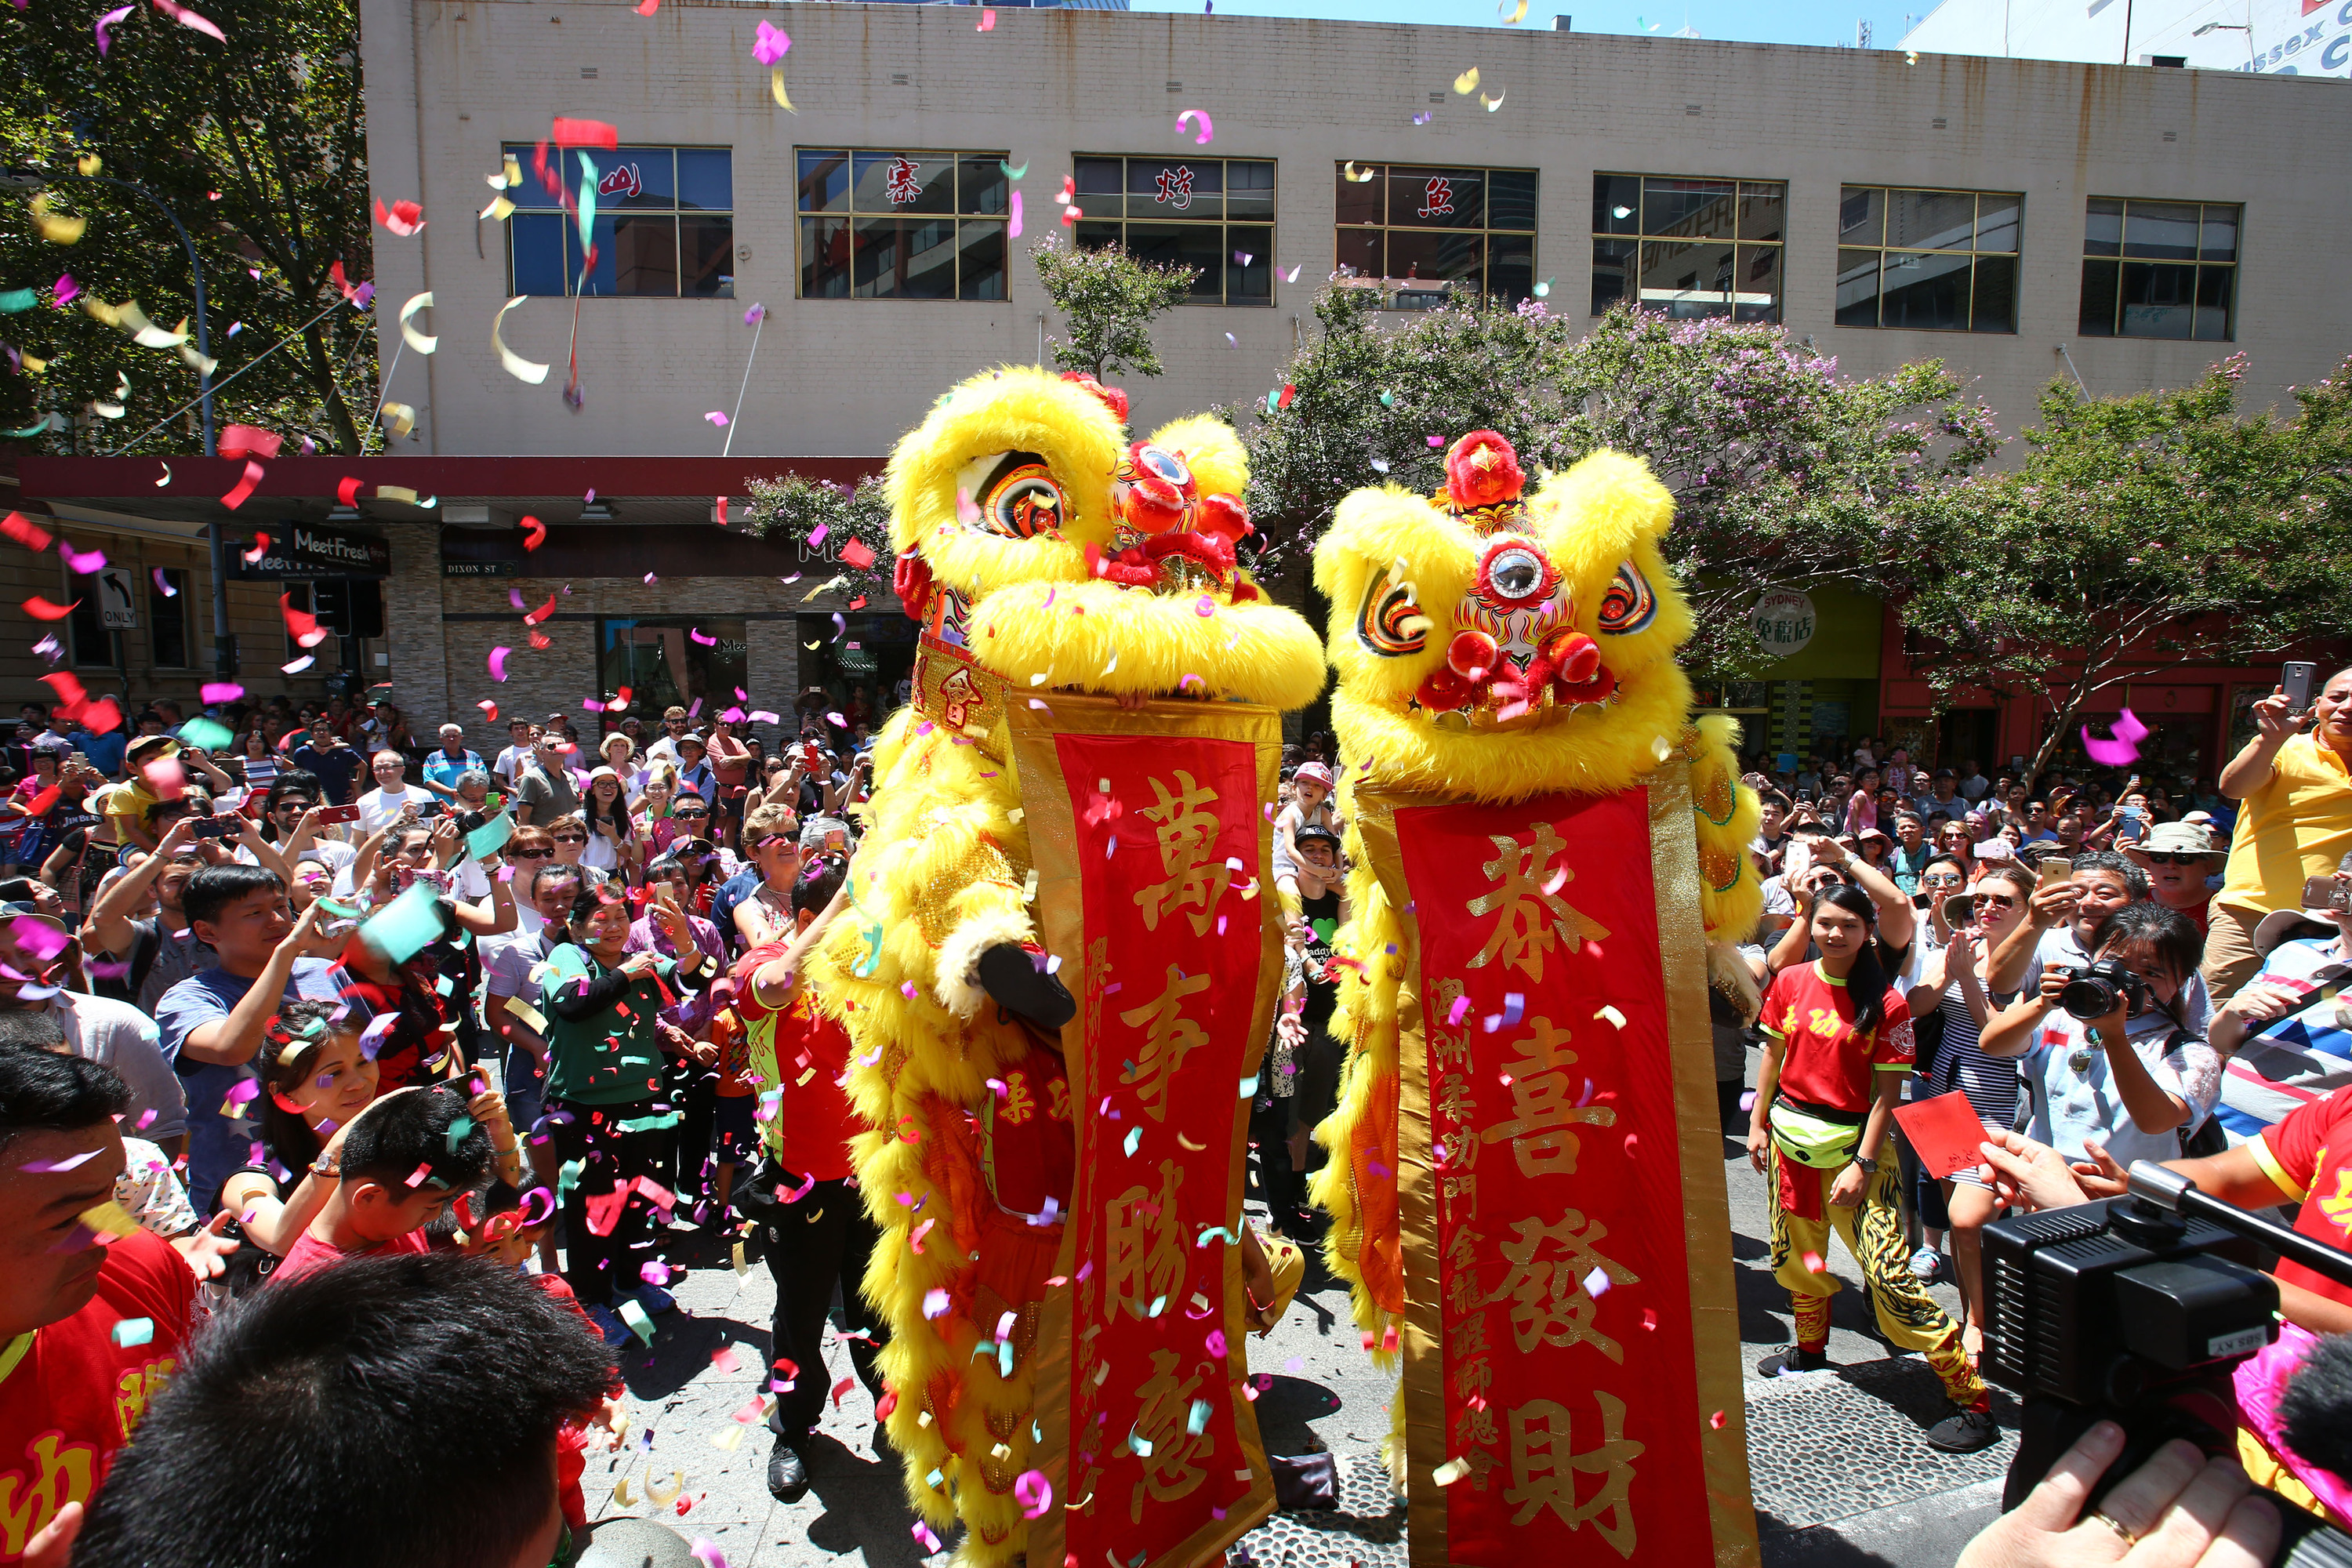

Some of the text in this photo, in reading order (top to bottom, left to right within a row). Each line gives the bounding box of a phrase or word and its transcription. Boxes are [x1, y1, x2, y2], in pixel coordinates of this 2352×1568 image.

[1155, 165, 1195, 210] 烤
[1417, 176, 1454, 218] 魚
[448, 564, 479, 573] DIXON
[1764, 594, 1805, 608] SYDNEY
[105, 612, 134, 622] ONLY
[1466, 822, 1646, 1560] 恭喜發財
